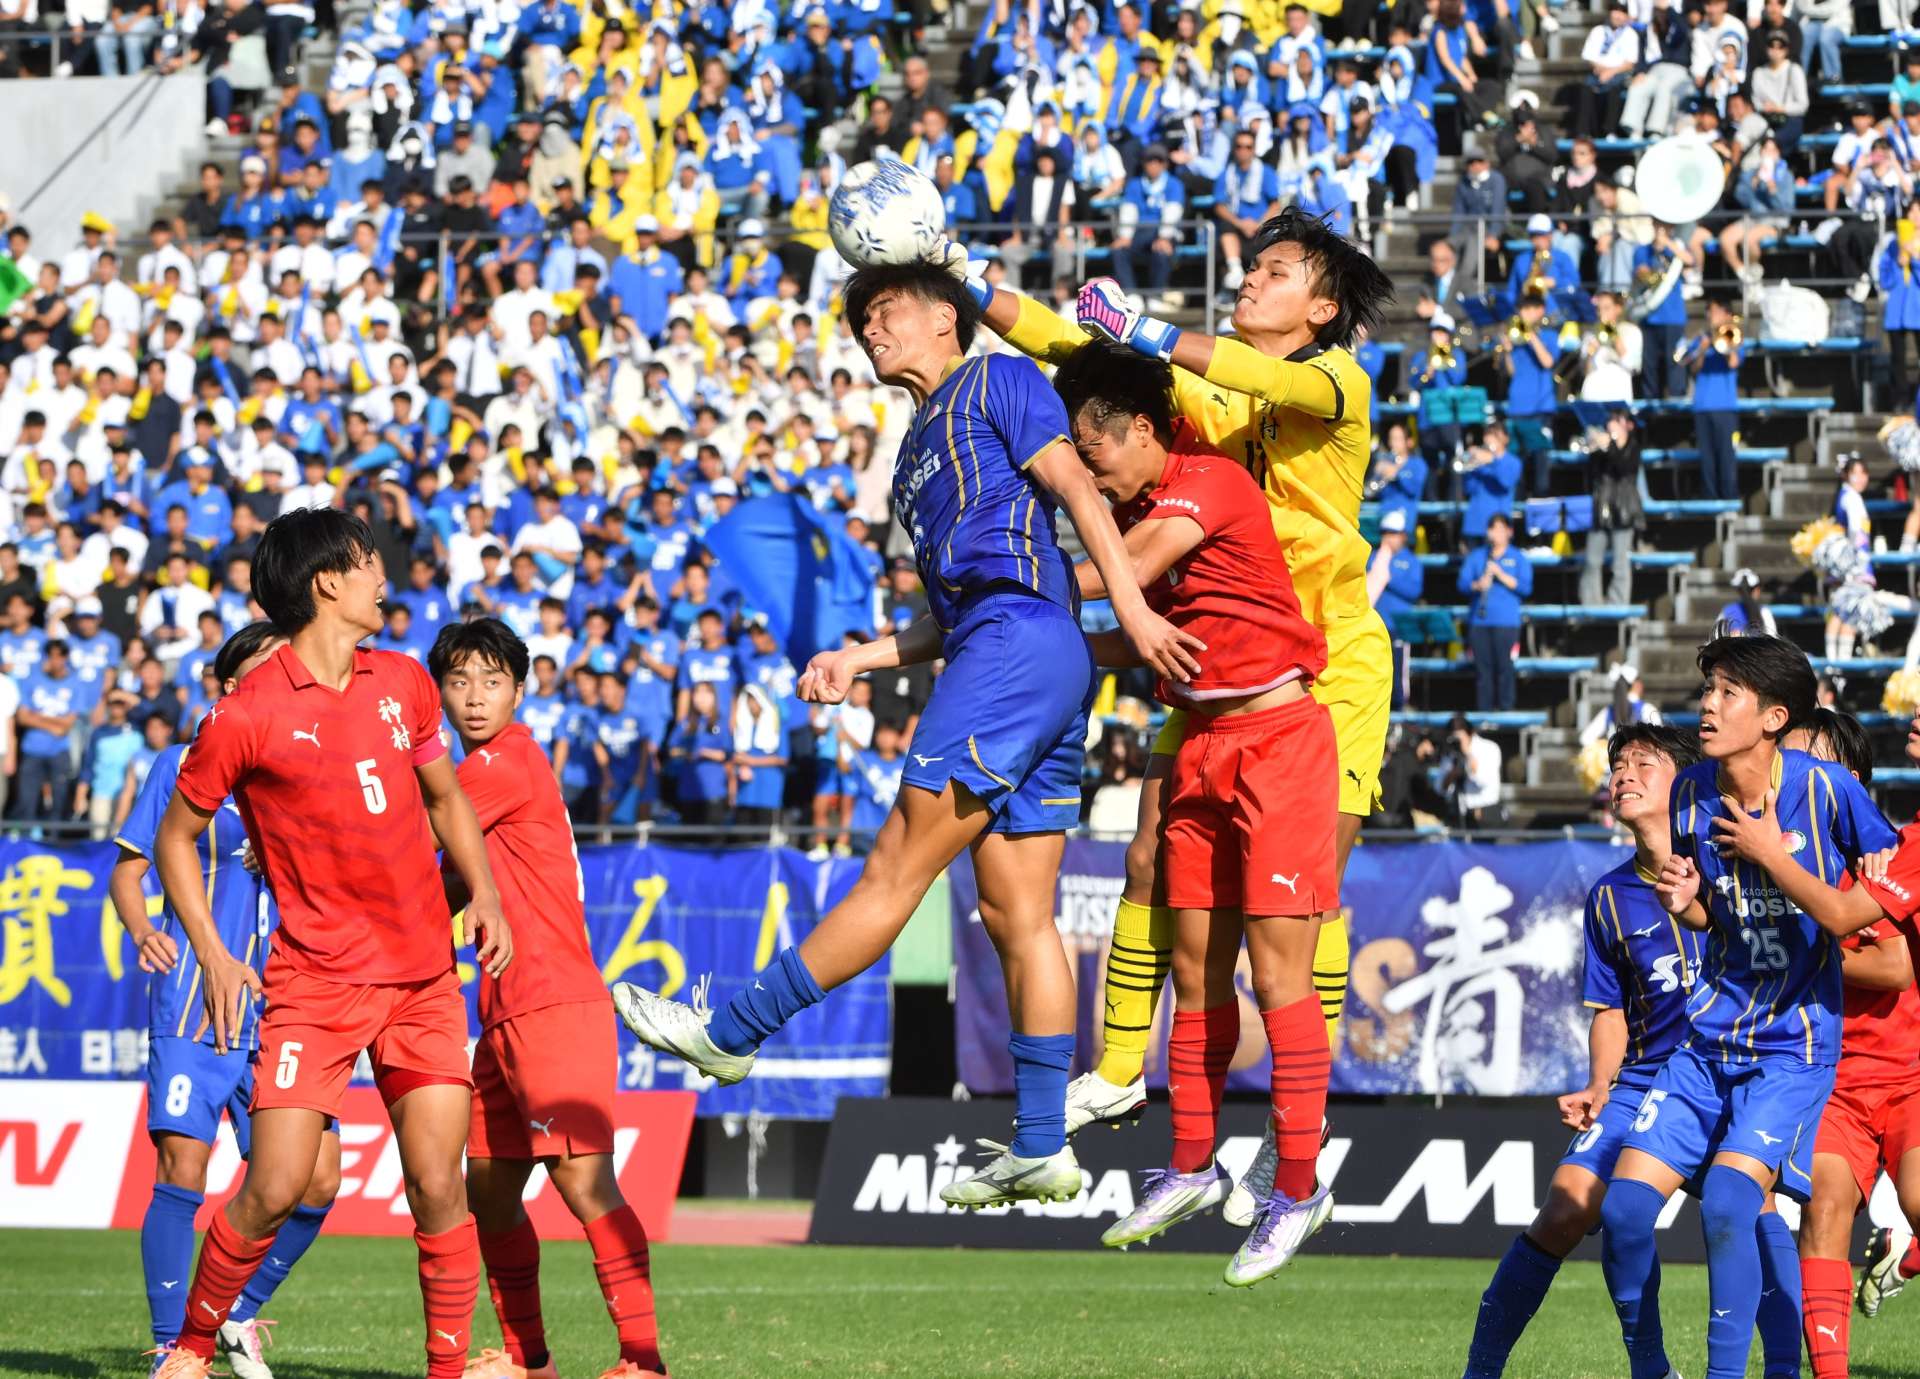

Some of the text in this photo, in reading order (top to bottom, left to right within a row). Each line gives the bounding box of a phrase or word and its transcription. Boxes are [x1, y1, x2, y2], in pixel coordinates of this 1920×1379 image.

[1261, 400, 1281, 441] 村
[378, 697, 411, 751] 神村
[355, 758, 388, 815] 5
[1735, 897, 1805, 918] JOSE
[1741, 887, 1784, 897] KAGOSH
[1740, 927, 1790, 970] 25
[275, 1041, 303, 1089] 5
[165, 1073, 193, 1118] 8
[1630, 1088, 1668, 1133] 5
